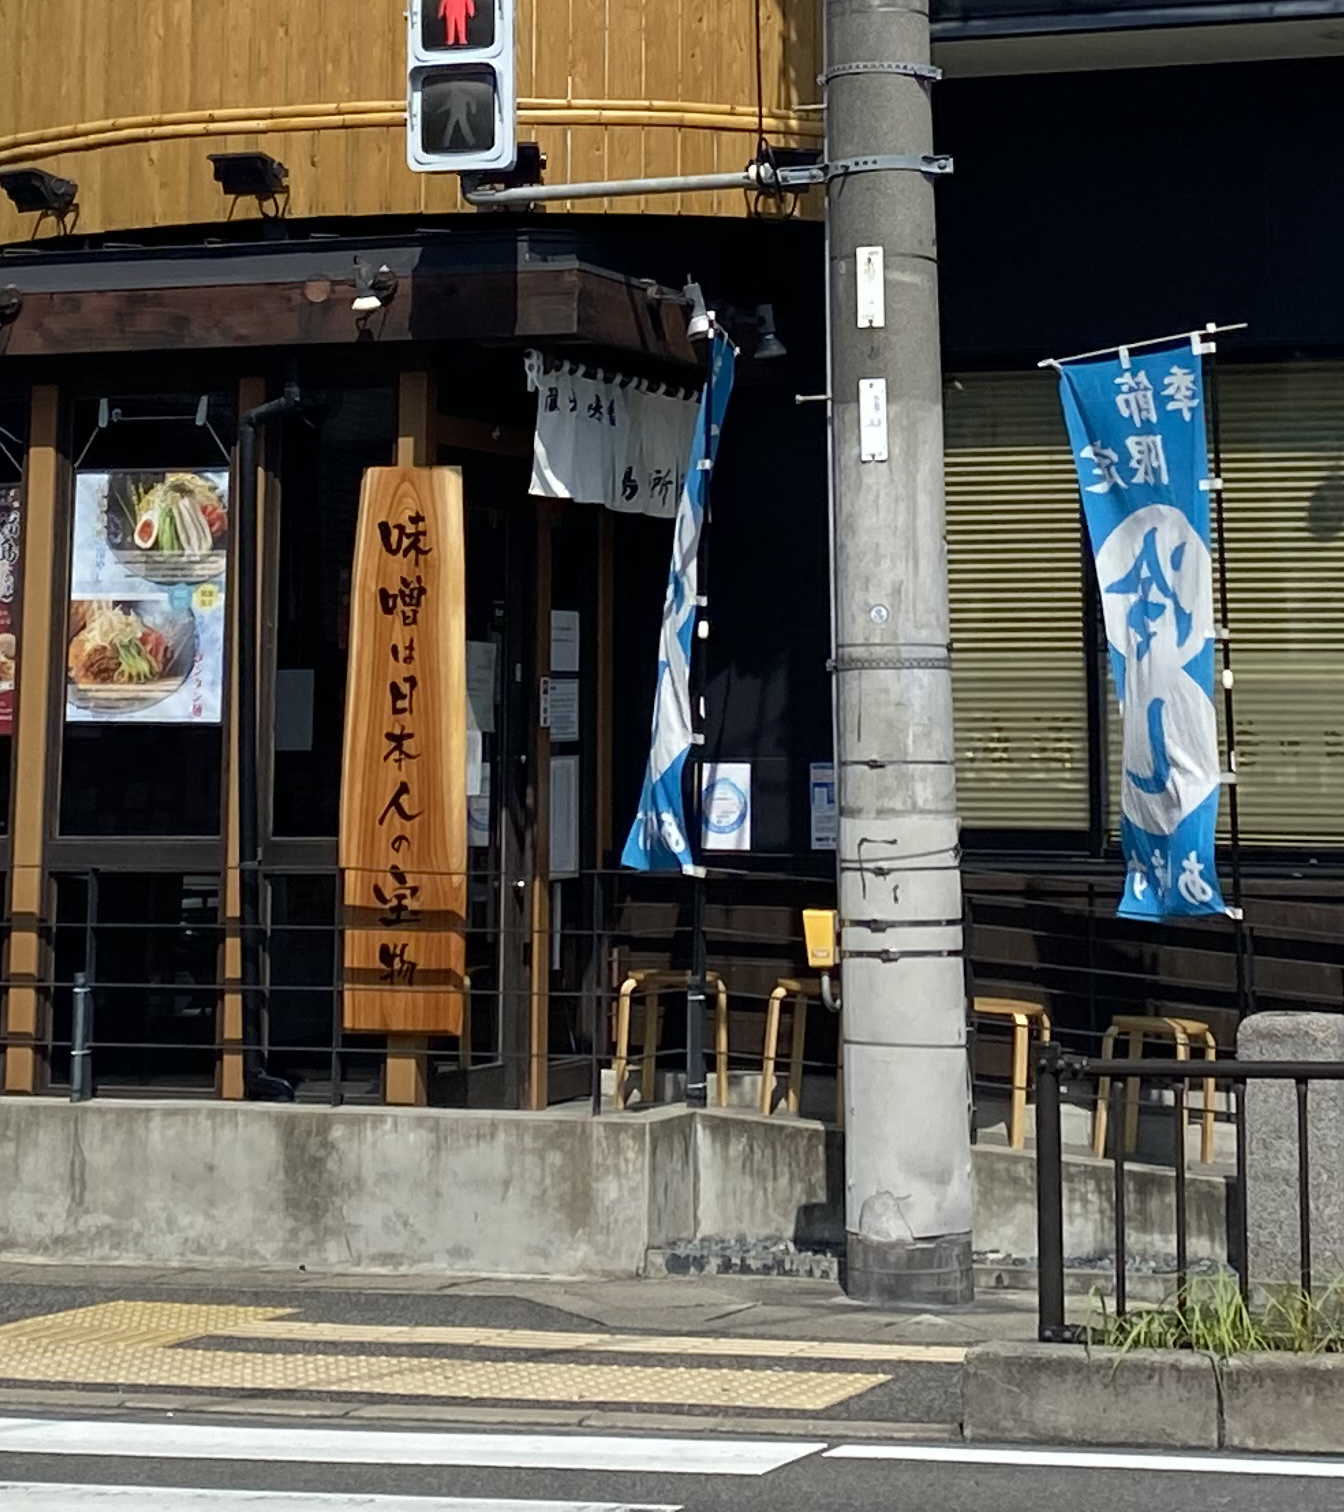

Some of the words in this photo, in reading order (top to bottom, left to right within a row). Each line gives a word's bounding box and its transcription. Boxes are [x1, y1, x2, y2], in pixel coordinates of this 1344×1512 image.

[372, 510, 433, 986] 味噌は日本人の宝物
